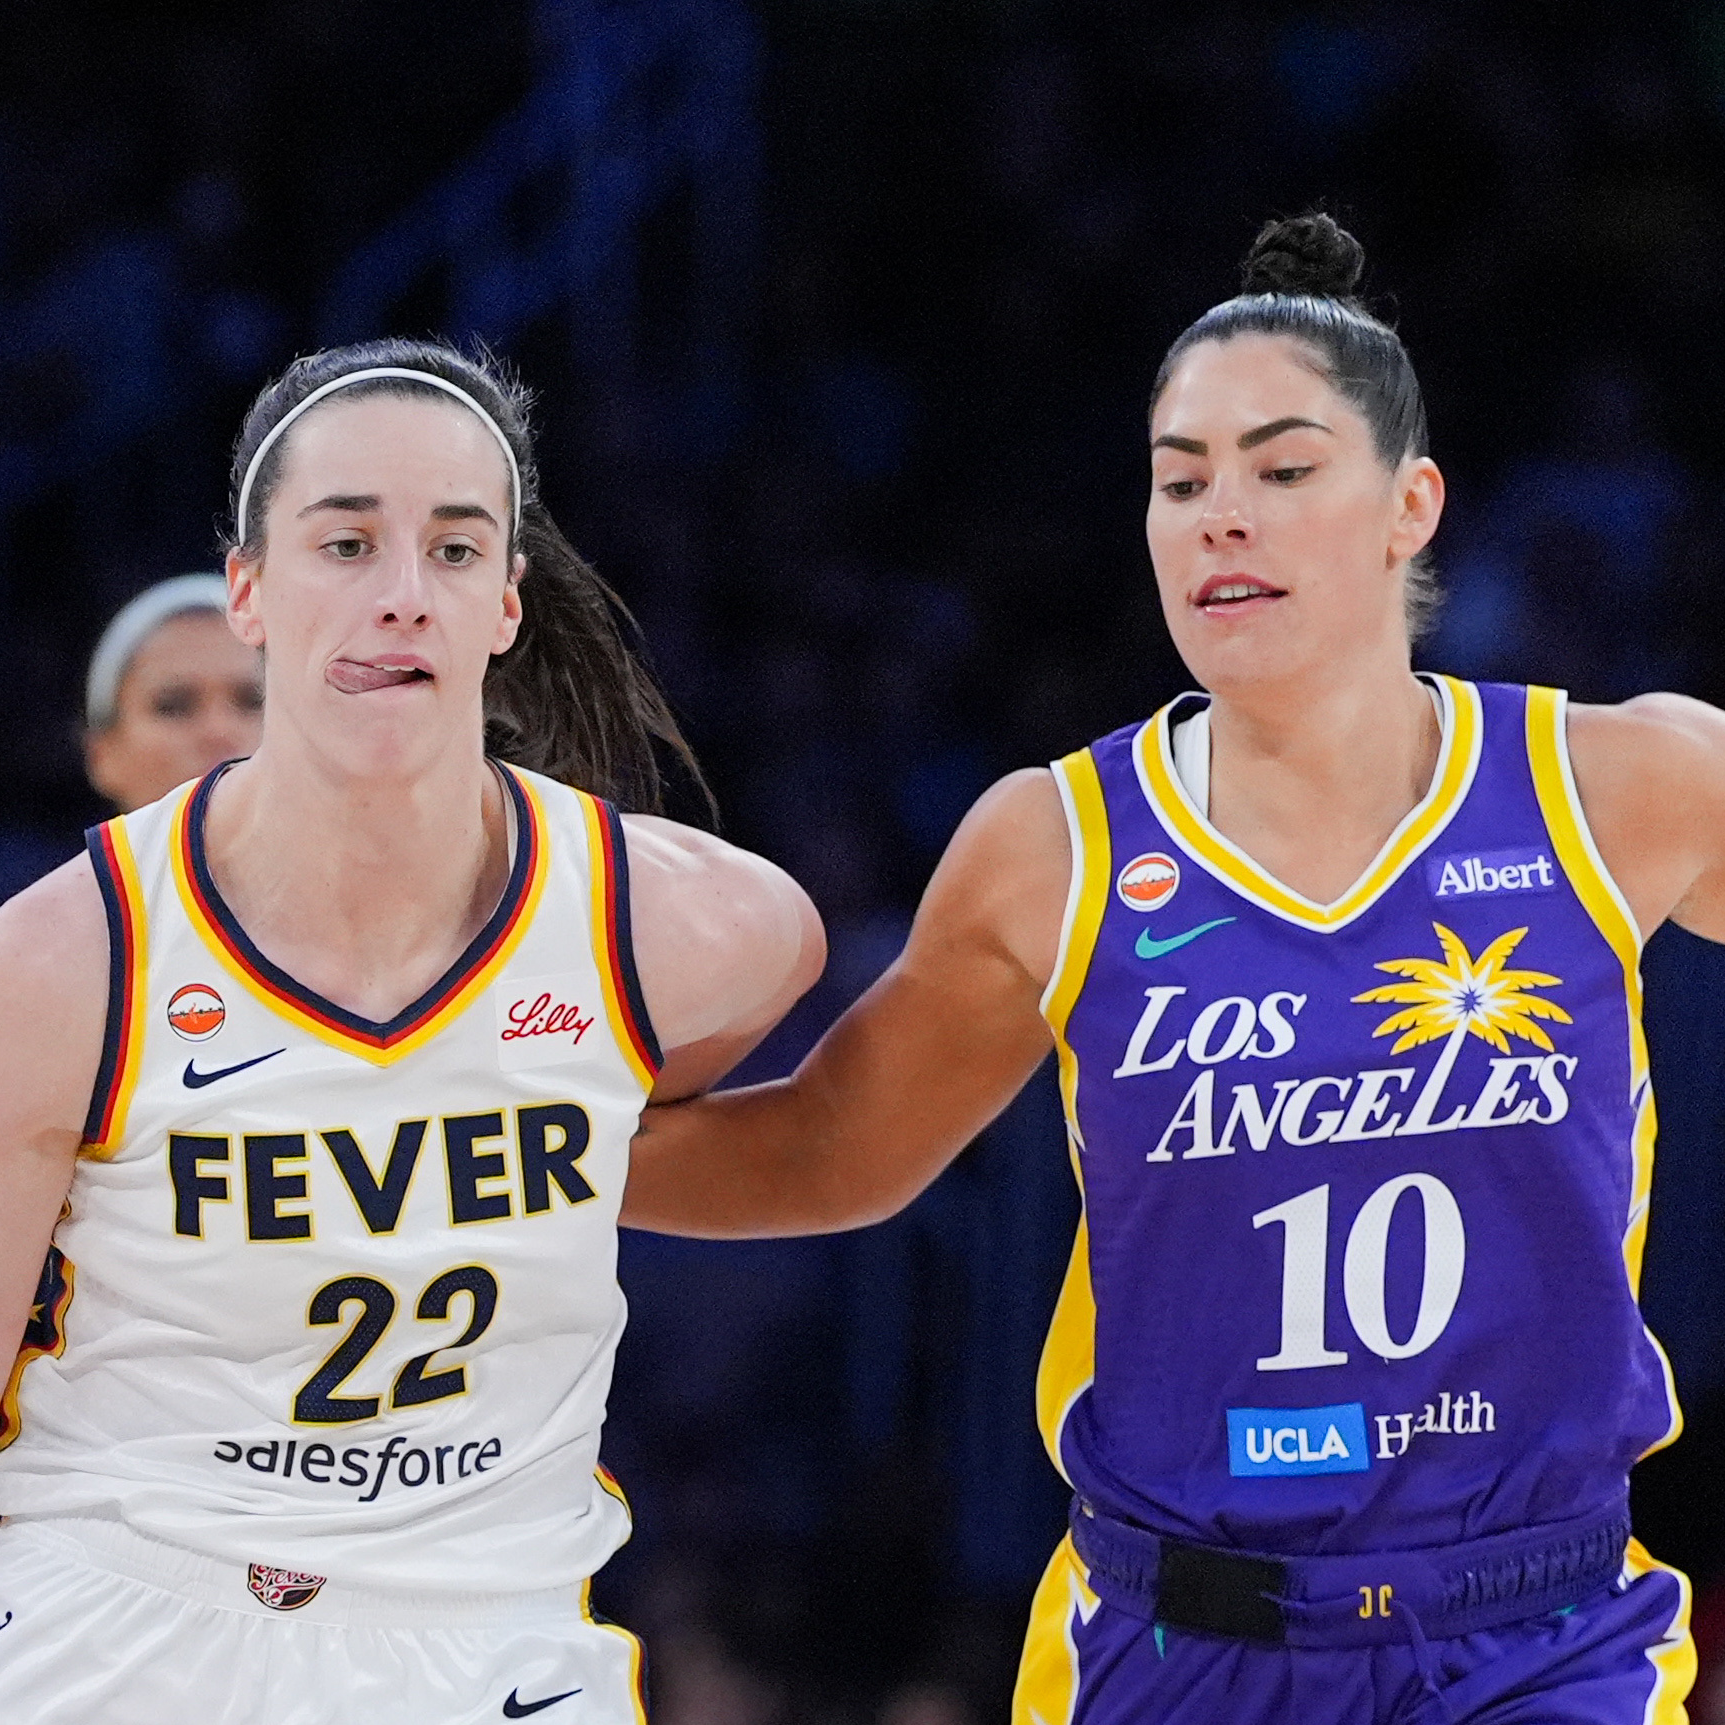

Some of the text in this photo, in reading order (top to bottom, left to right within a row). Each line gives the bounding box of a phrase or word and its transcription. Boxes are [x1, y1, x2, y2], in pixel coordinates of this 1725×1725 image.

[1434, 854, 1555, 897] Albert
[500, 992, 595, 1045] Lilly
[166, 1099, 599, 1244] FEVER
[1251, 1171, 1467, 1372] 10
[289, 1260, 501, 1429] 22
[1245, 1390, 1496, 1464] UCLA Halth
